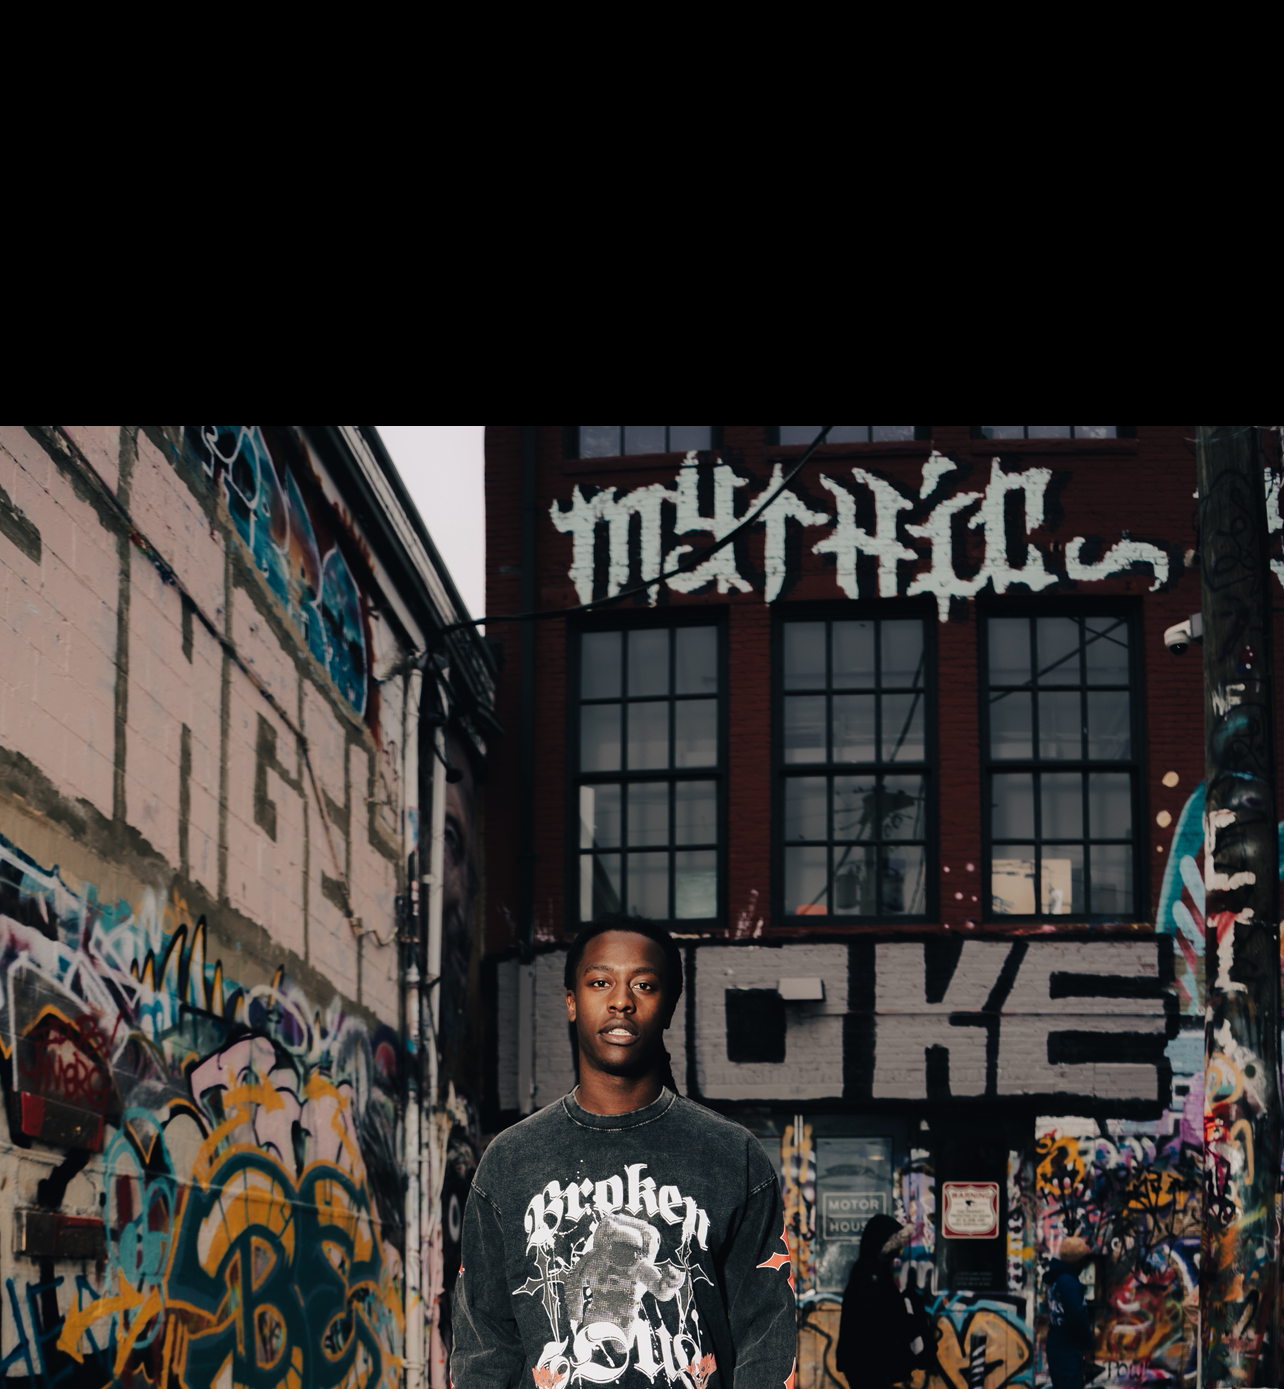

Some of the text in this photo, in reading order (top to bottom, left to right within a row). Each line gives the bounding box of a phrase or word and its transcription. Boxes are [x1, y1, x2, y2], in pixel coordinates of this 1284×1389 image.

[492, 938, 1178, 1118] OKE
[951, 1191, 992, 1200] WARNING
[524, 1163, 711, 1256] Broken
[828, 1198, 879, 1211] MOTOR
[829, 1221, 868, 1233] HOUS
